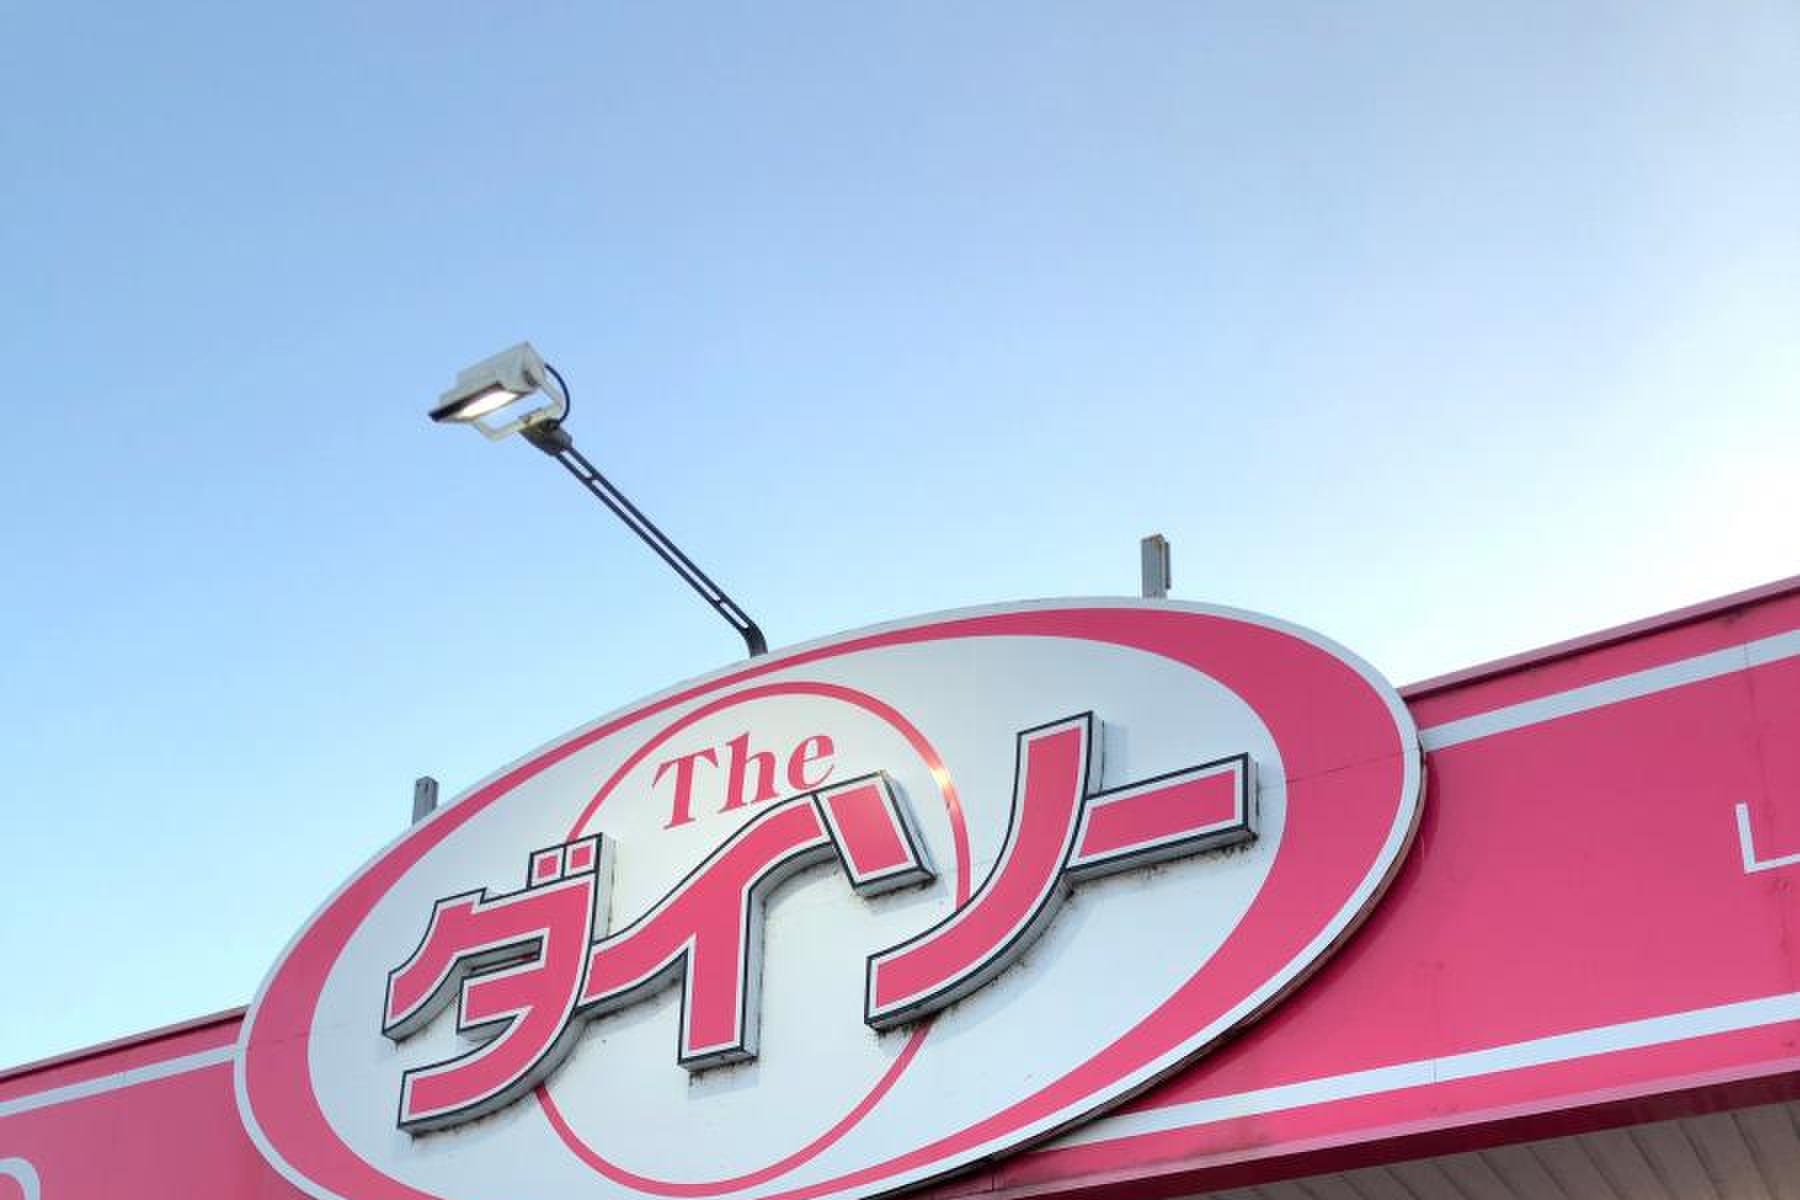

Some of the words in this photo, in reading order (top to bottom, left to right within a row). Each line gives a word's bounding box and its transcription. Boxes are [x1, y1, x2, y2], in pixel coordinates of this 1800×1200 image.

[652, 731, 834, 829] The
[381, 710, 1258, 1135] ダイソー
